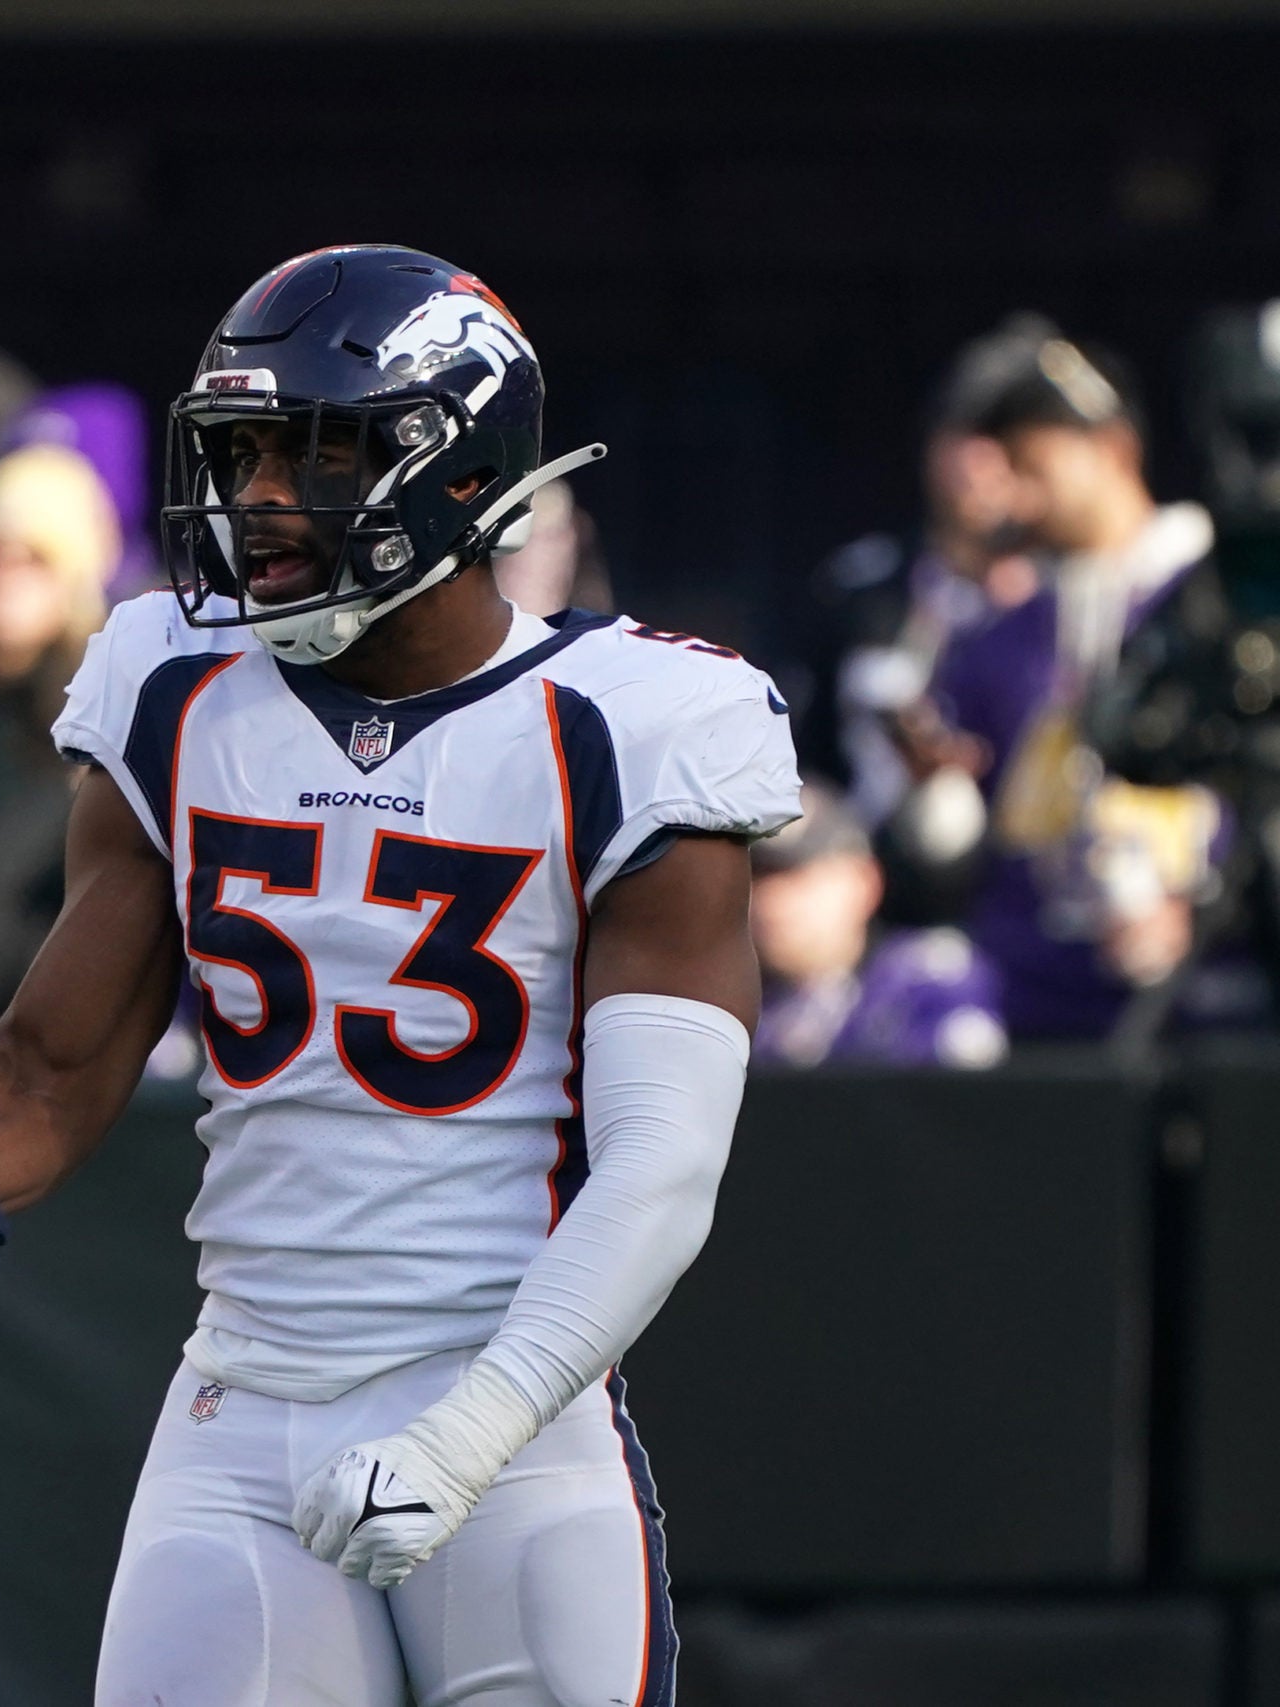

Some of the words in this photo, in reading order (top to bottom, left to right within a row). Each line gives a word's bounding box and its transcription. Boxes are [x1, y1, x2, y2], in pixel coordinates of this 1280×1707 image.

[356, 738, 382, 756] NFL
[299, 792, 424, 815] BRONCOS
[188, 807, 546, 1116] 53
[194, 1399, 214, 1414] NFL
